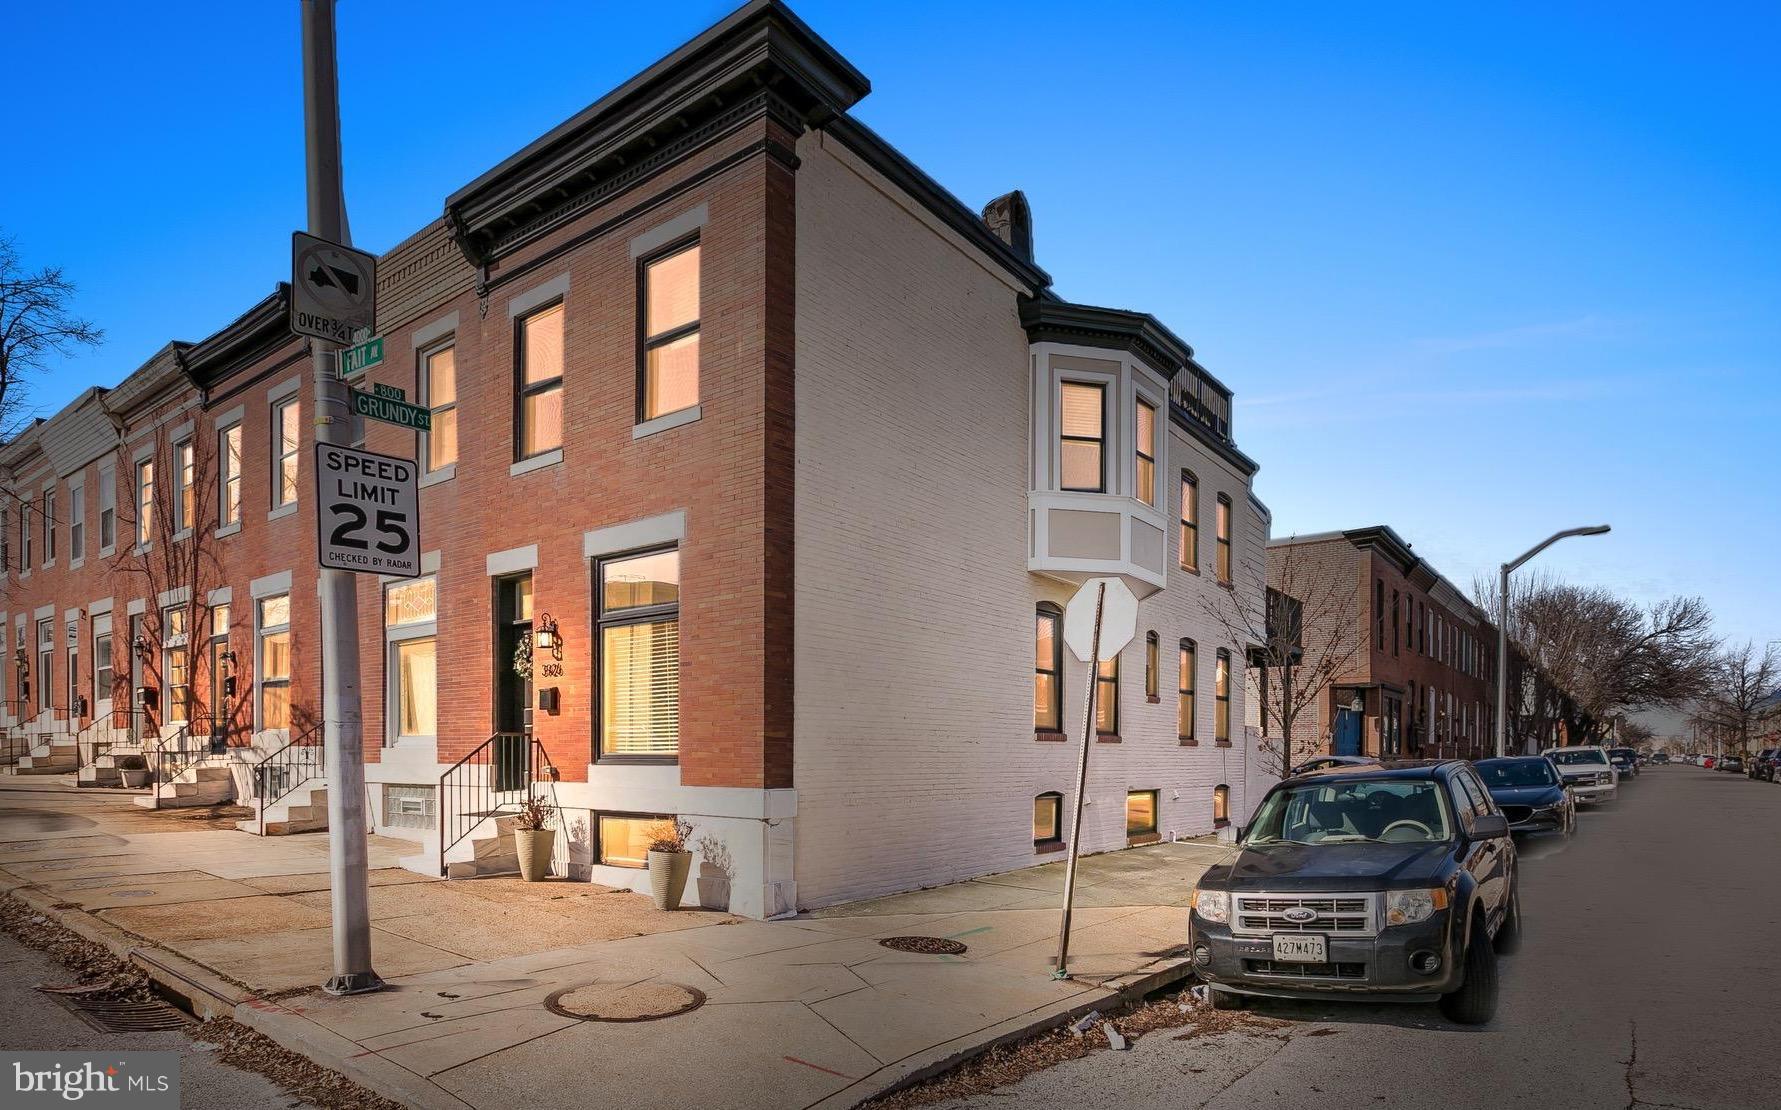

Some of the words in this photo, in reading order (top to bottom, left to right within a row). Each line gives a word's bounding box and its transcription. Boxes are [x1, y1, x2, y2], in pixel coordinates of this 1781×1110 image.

[299, 312, 329, 332] OVER
[347, 346, 367, 371] FAIT
[380, 385, 402, 400] 800
[357, 395, 417, 426] GRUNDY
[418, 414, 431, 427] ST
[326, 451, 410, 483] SPEED
[338, 479, 400, 506] LIMIT
[329, 503, 411, 555] 25
[329, 551, 369, 565] CHECKED
[372, 557, 383, 567] BY
[386, 559, 412, 570] RADAR
